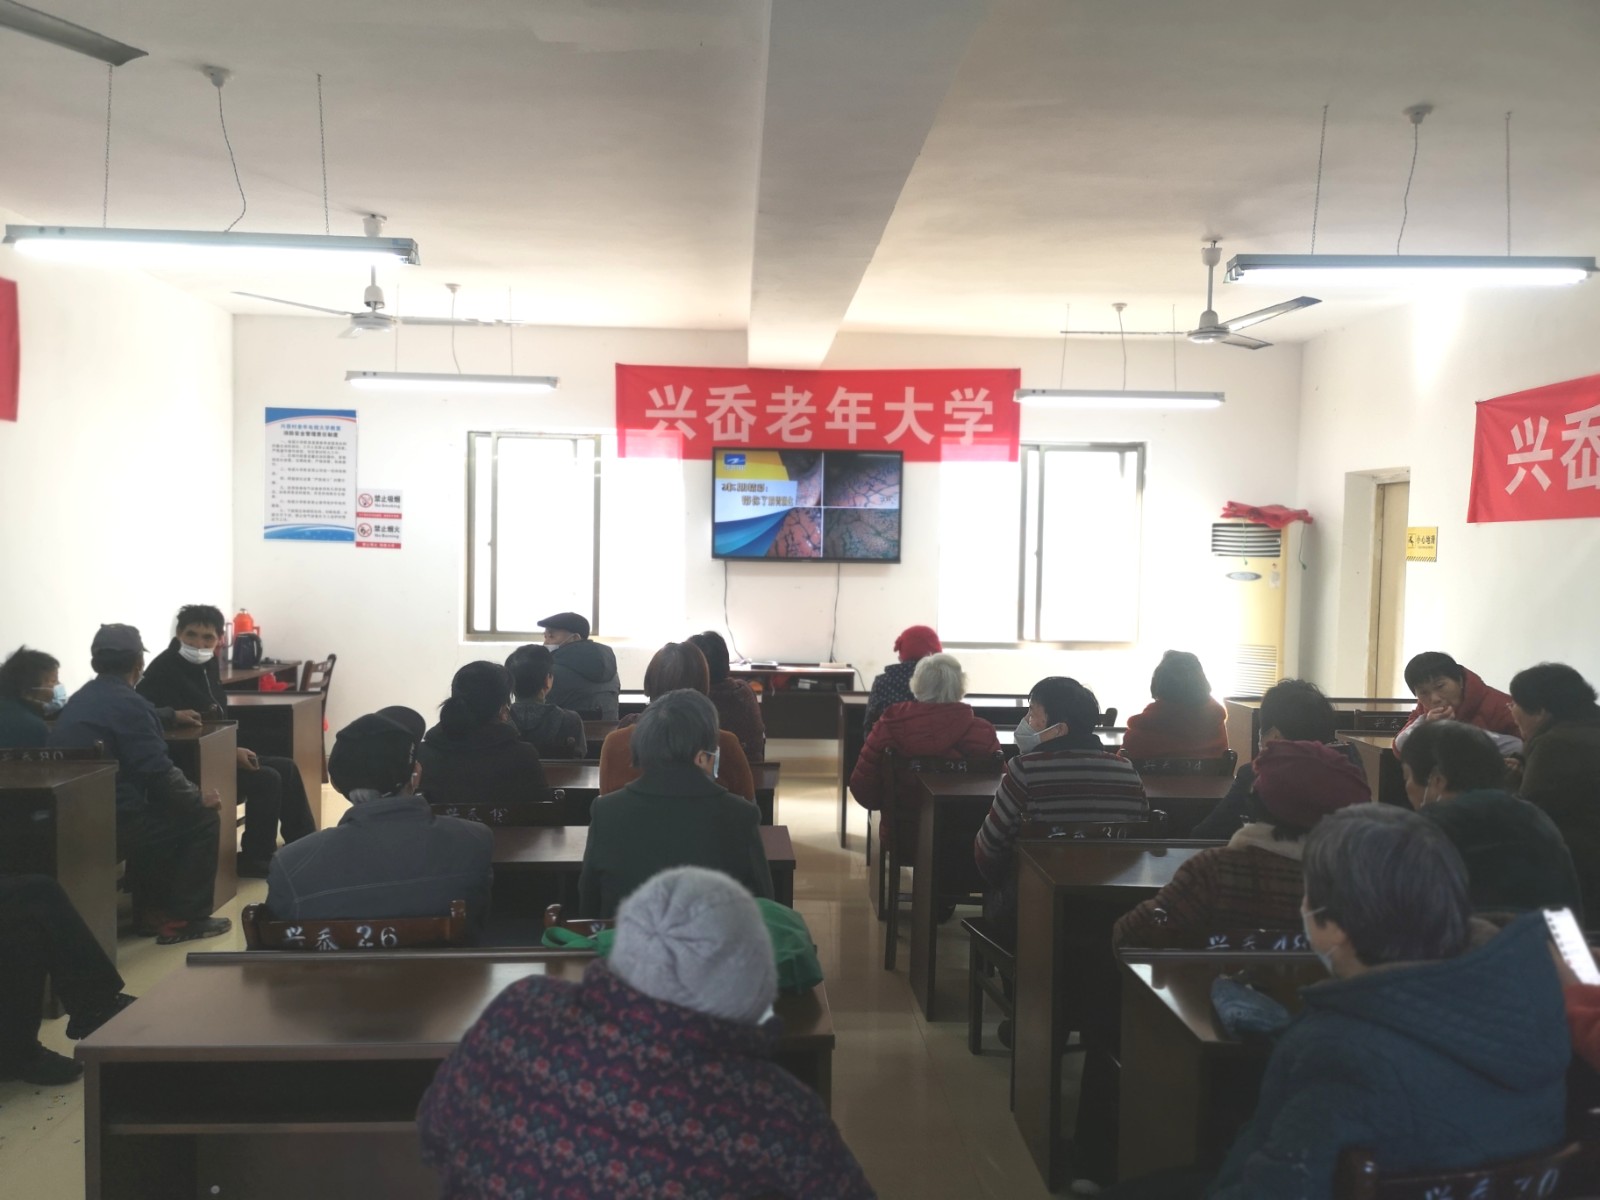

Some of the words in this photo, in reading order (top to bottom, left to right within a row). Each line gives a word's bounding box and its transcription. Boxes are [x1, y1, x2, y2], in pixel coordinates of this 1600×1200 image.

[645, 384, 993, 445] 兴岙老年大学
[356, 925, 398, 947] 26
